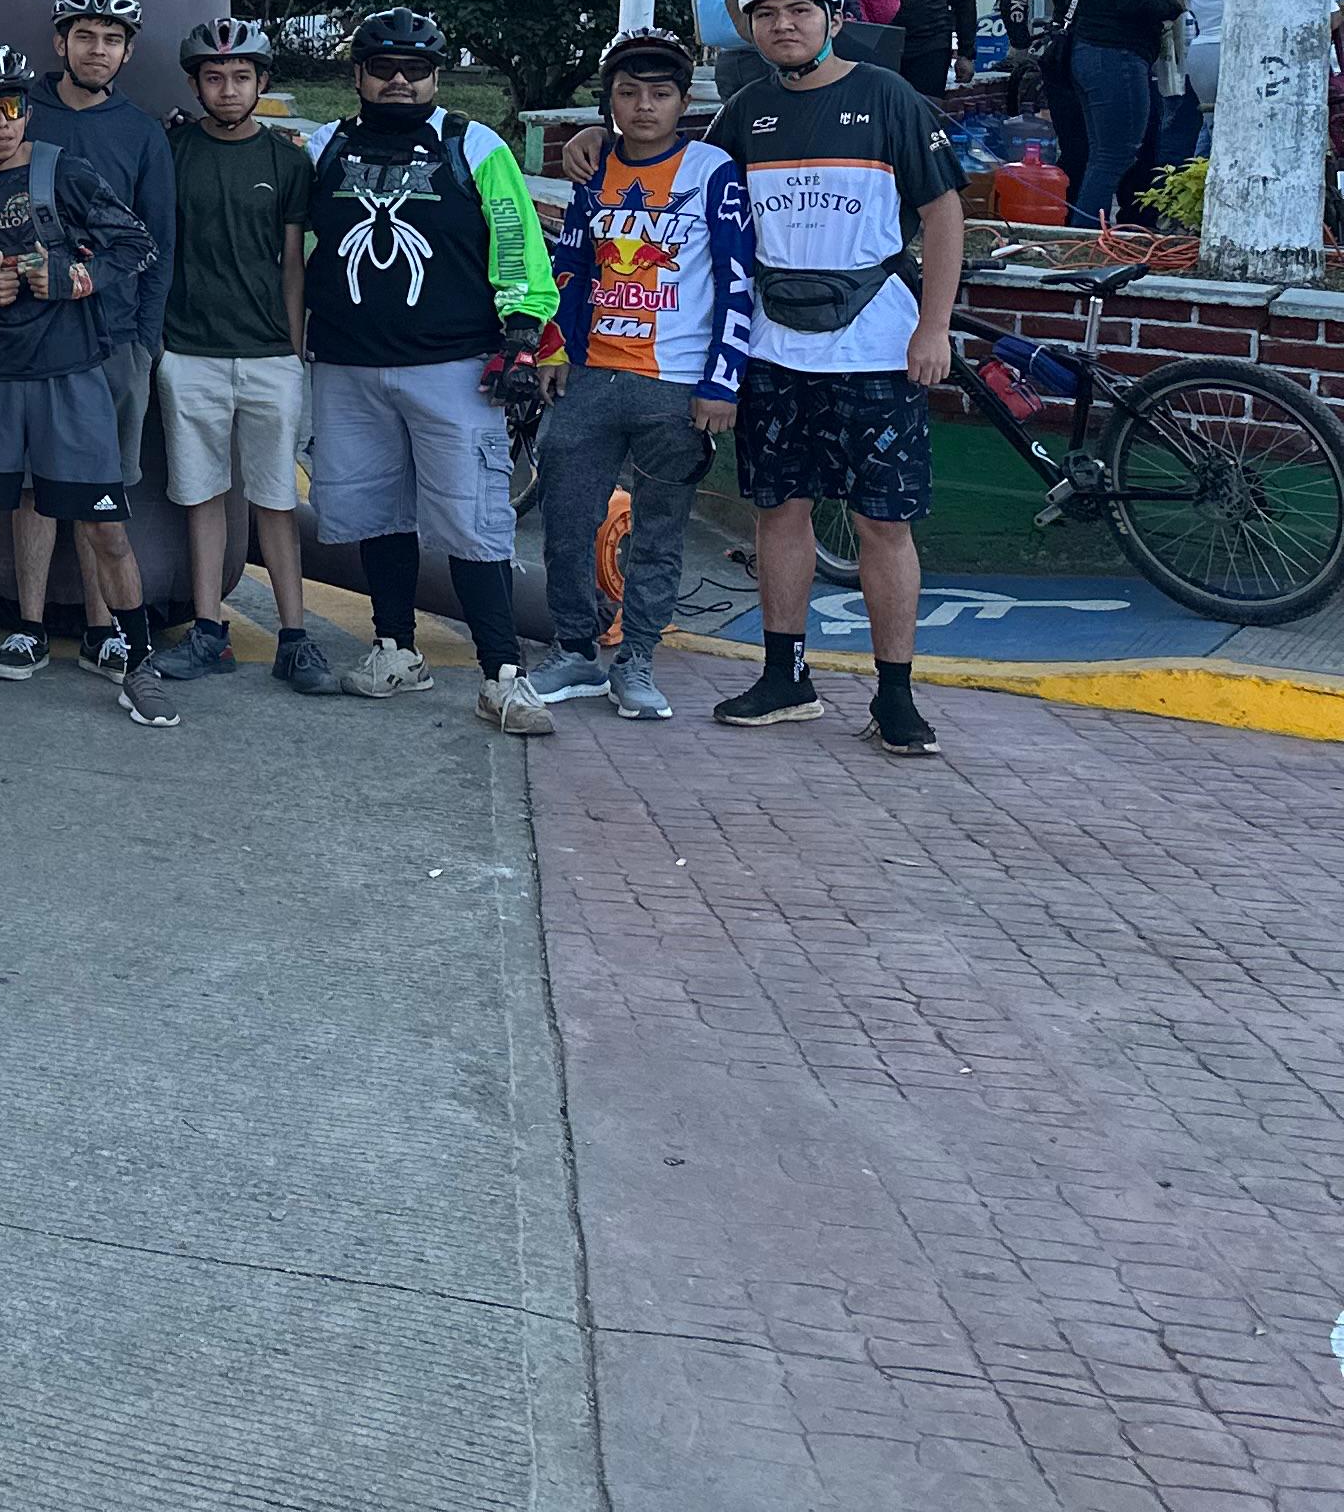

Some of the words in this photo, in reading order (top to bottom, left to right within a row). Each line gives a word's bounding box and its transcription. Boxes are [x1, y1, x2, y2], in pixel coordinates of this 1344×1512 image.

[786, 173, 821, 187] CAFÉ
[753, 191, 794, 218] DON
[797, 192, 862, 215] JUSTO
[489, 197, 528, 281] MOTOCROSS
[591, 315, 653, 338] KTM
